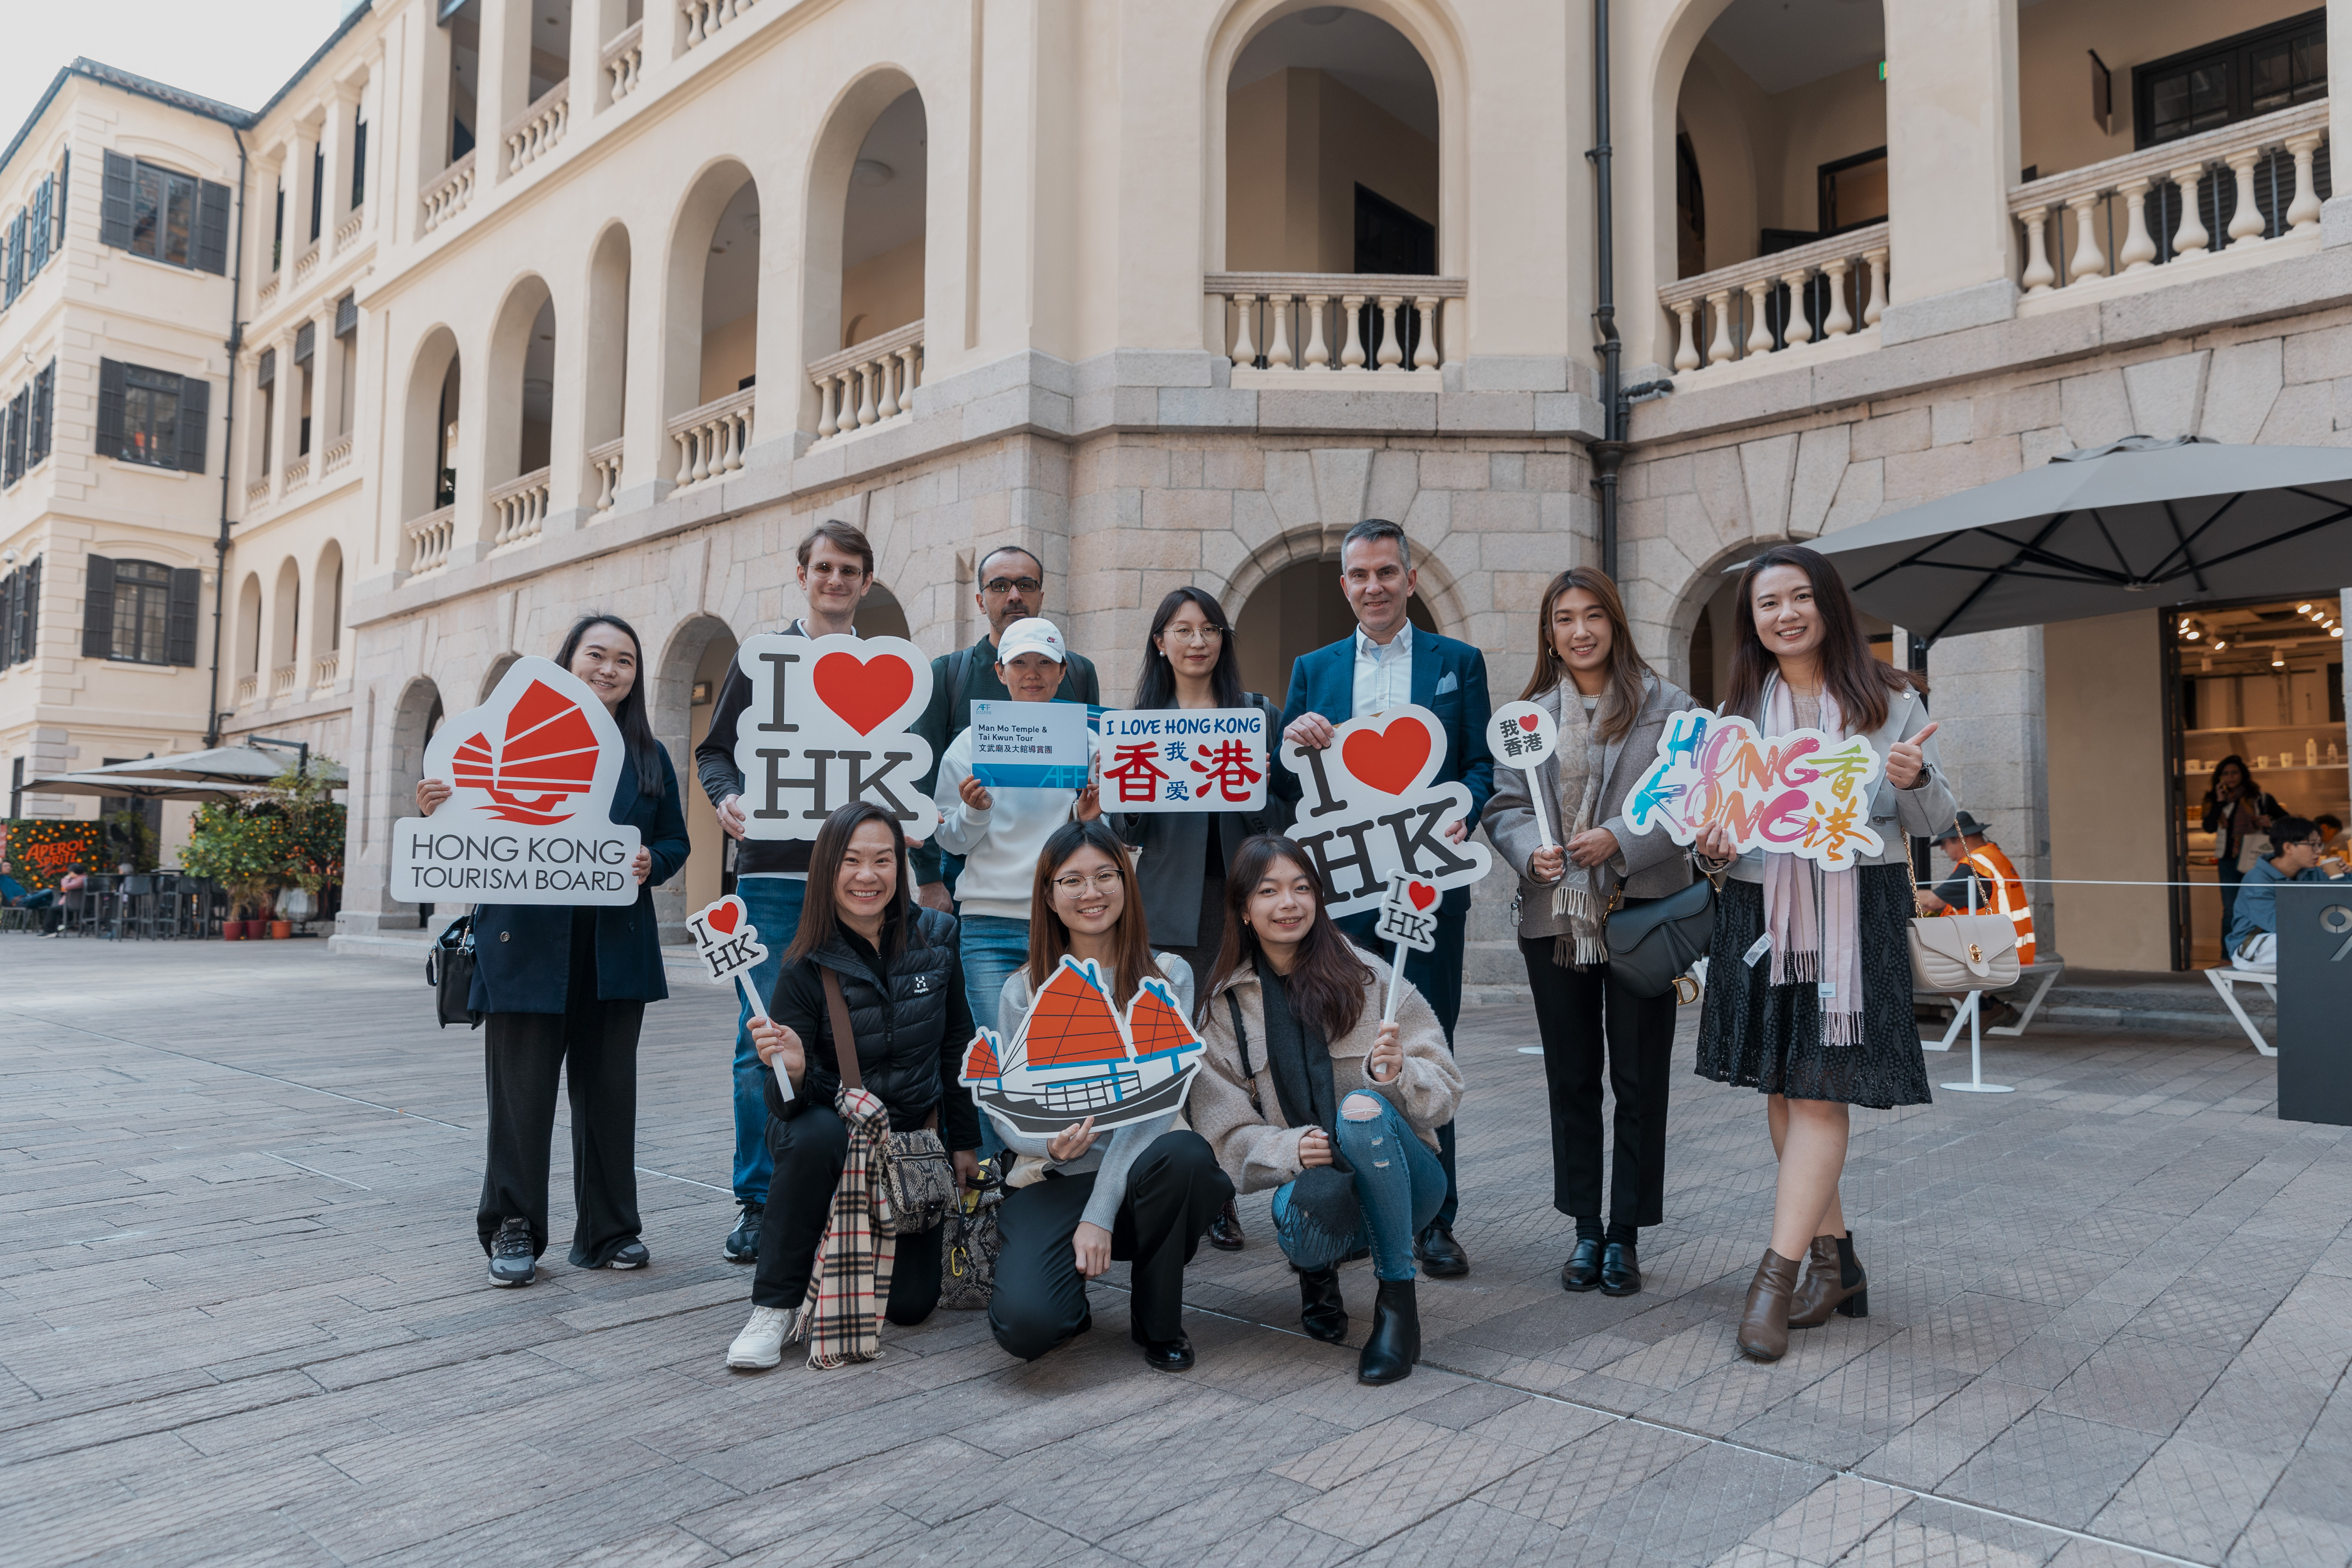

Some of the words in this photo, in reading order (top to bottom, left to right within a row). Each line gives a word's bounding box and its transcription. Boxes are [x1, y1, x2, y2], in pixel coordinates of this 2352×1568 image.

[757, 653, 800, 732] I
[1011, 725, 1039, 734] Temple
[1106, 720, 1114, 735] I
[1121, 719, 1161, 735] LOVE
[1165, 718, 1211, 734] HONG
[1214, 717, 1261, 733] KONG
[1499, 719, 1519, 738] 我
[979, 744, 1053, 754] 文武廟及大館導賞團
[1504, 733, 1543, 757] 香港
[1668, 717, 1823, 792] HONG
[753, 748, 919, 821] HK
[1294, 743, 1348, 818] I
[1632, 764, 1820, 844] KONG
[1802, 744, 1874, 862] 香港
[25, 839, 87, 861] APEROL
[412, 834, 519, 862] HONG
[528, 838, 626, 865] KONG
[1297, 797, 1477, 904] HK
[411, 867, 528, 889] TOURISM
[535, 870, 624, 891] BOARD
[1390, 875, 1407, 905] I
[691, 918, 713, 949] I
[1384, 907, 1432, 945] HK
[705, 933, 760, 978] HK
